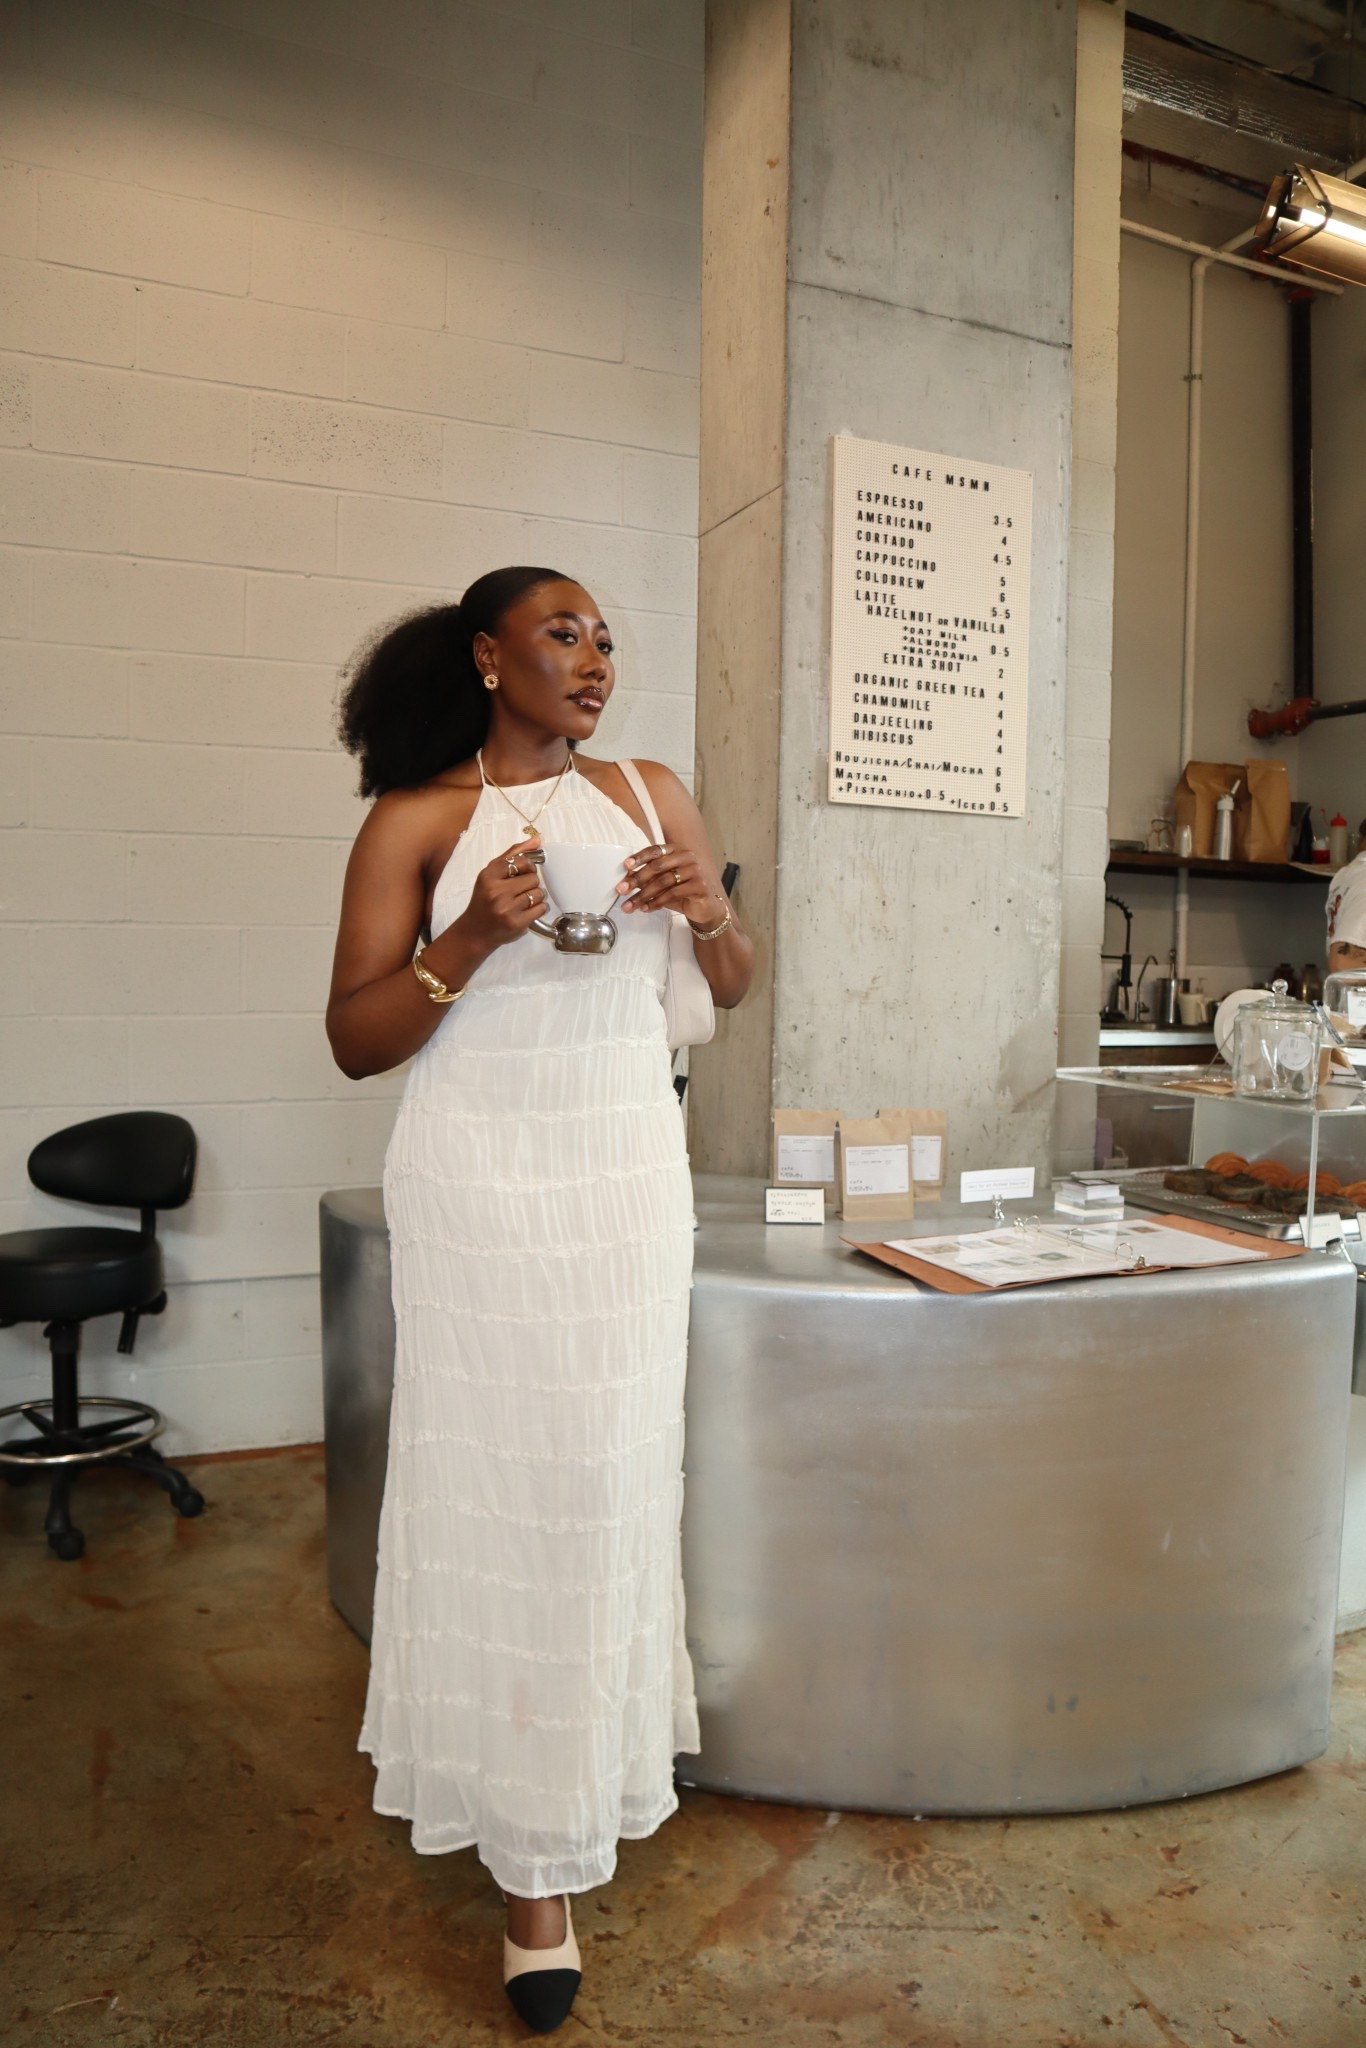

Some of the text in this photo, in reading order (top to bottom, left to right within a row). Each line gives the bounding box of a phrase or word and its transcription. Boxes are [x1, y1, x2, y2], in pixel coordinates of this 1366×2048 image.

[892, 463, 990, 492] CAFE MSMN
[857, 489, 924, 512] ESPRESSO
[856, 529, 914, 549] CORTADO
[857, 509, 1007, 546] AMERICANO 4
[856, 549, 1006, 587] CAPPUCCINO 5
[855, 589, 896, 606] LATTE
[856, 569, 1006, 603] COLDBREW 6
[867, 604, 932, 623] HAZELNUT
[954, 617, 1005, 634] VANILLA
[940, 631, 967, 642] MILK
[883, 652, 1004, 679] EXTRA SHOT 2
[854, 672, 1004, 701] ORGANIC GREEN TEA 4
[854, 692, 1003, 720] CHAMOMILE 4
[853, 712, 1003, 739] DARJEELING 4
[853, 729, 1003, 754] HIBISCUS 4
[996, 766, 1002, 777] 6
[995, 782, 1001, 793] 6
